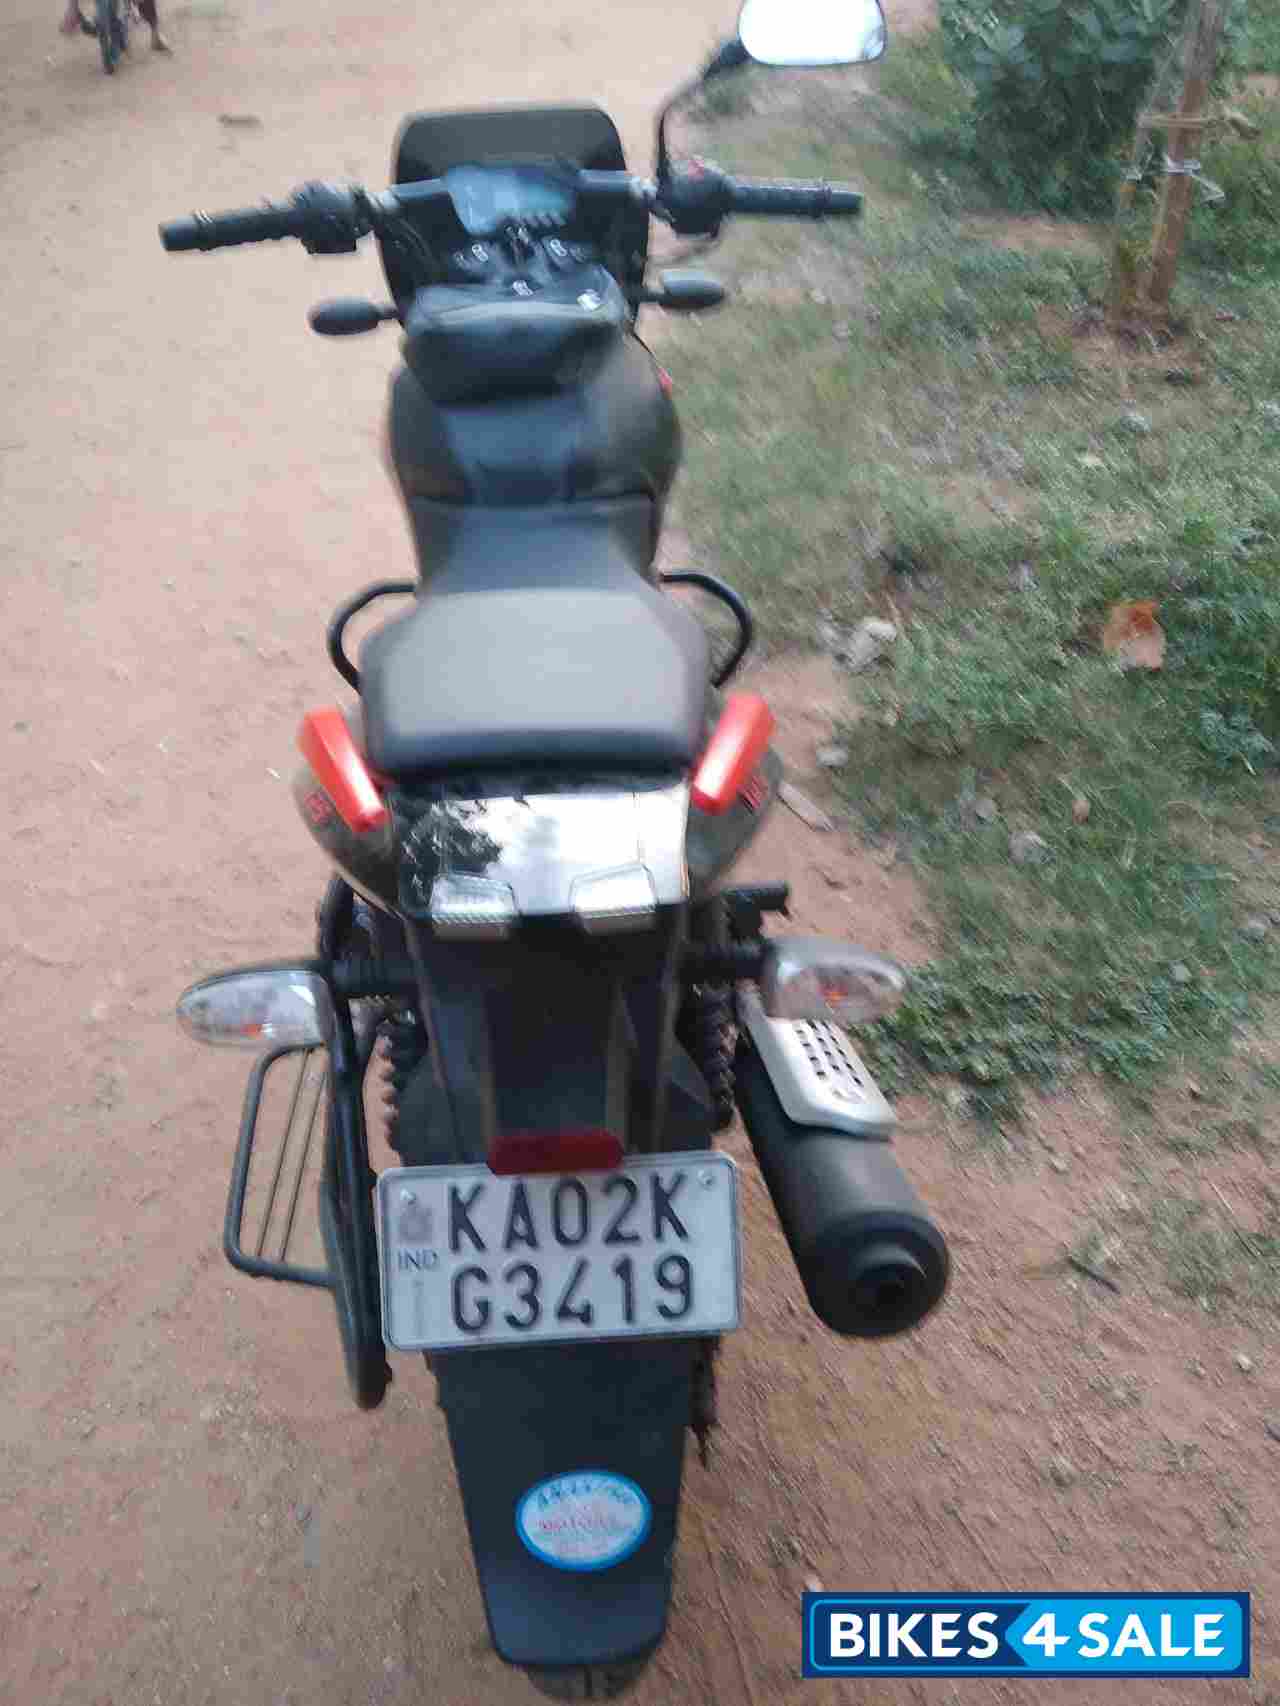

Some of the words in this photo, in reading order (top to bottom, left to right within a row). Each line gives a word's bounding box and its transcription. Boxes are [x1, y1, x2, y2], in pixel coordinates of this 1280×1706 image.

[447, 1172, 689, 1251] KA02K
[398, 1249, 438, 1271] IND
[451, 1253, 692, 1332] G3419
